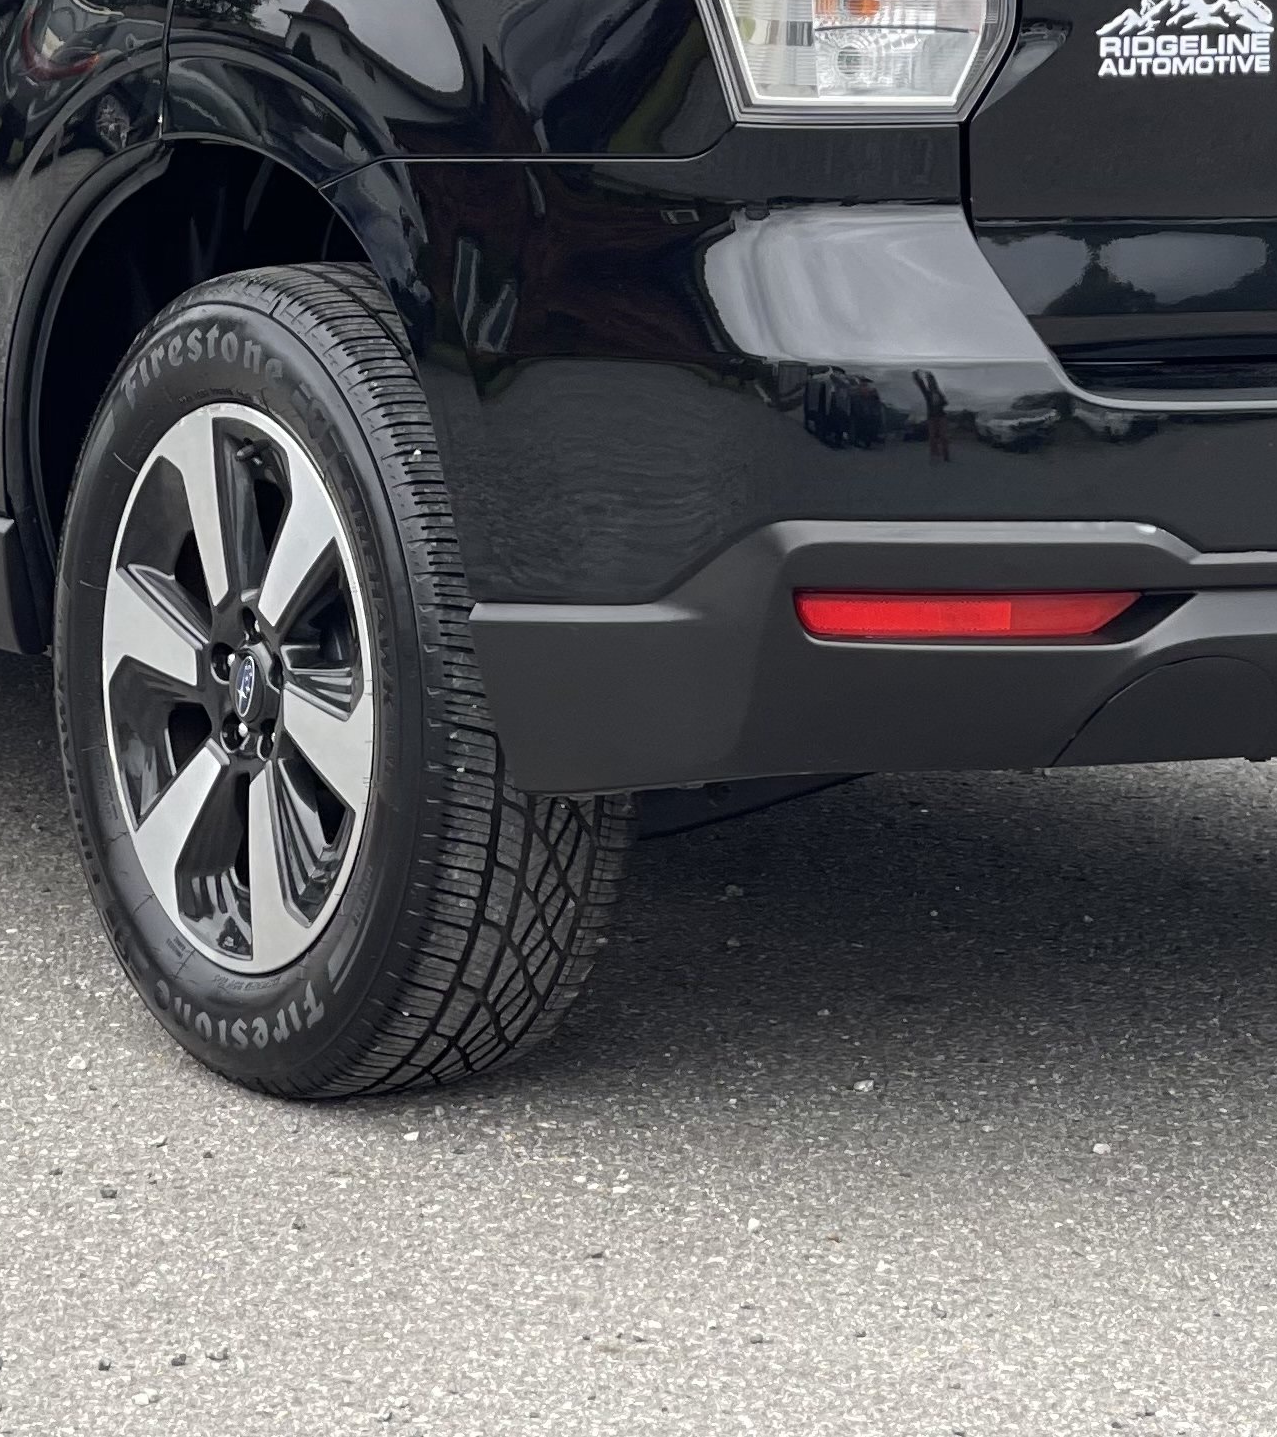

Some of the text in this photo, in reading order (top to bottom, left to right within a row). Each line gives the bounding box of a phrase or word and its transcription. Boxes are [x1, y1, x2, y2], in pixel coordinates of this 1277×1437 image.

[1099, 32, 1271, 58] RIDGELINE
[1097, 54, 1271, 78] AUTOMOTIVE
[121, 323, 284, 410] Firestone
